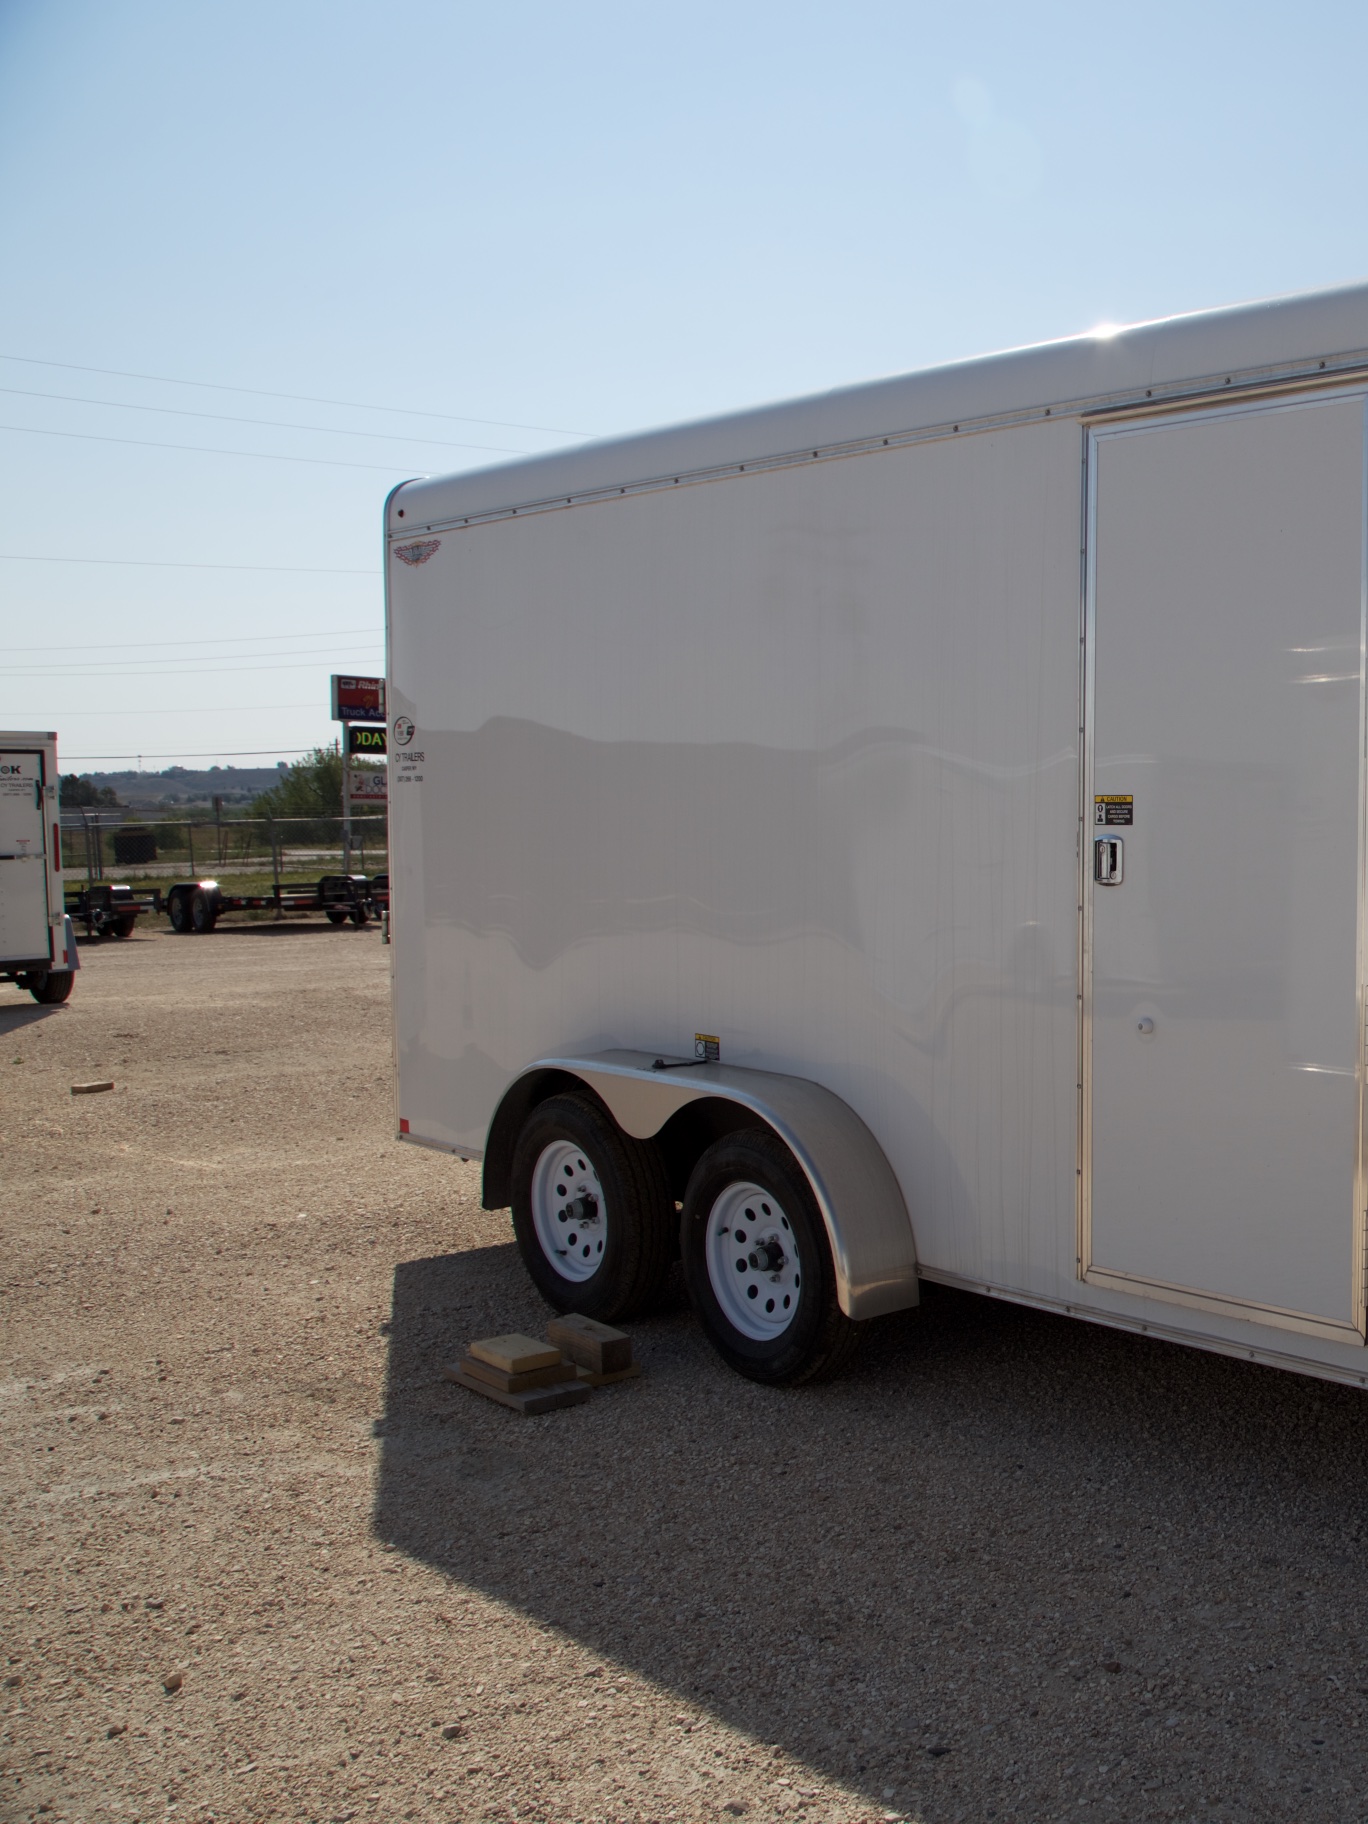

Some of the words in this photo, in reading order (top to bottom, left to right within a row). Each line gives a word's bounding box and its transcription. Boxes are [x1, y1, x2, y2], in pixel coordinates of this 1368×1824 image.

[357, 680, 381, 690] Rhin
[341, 706, 366, 717] Truck
[401, 752, 425, 762] TRAILERS
